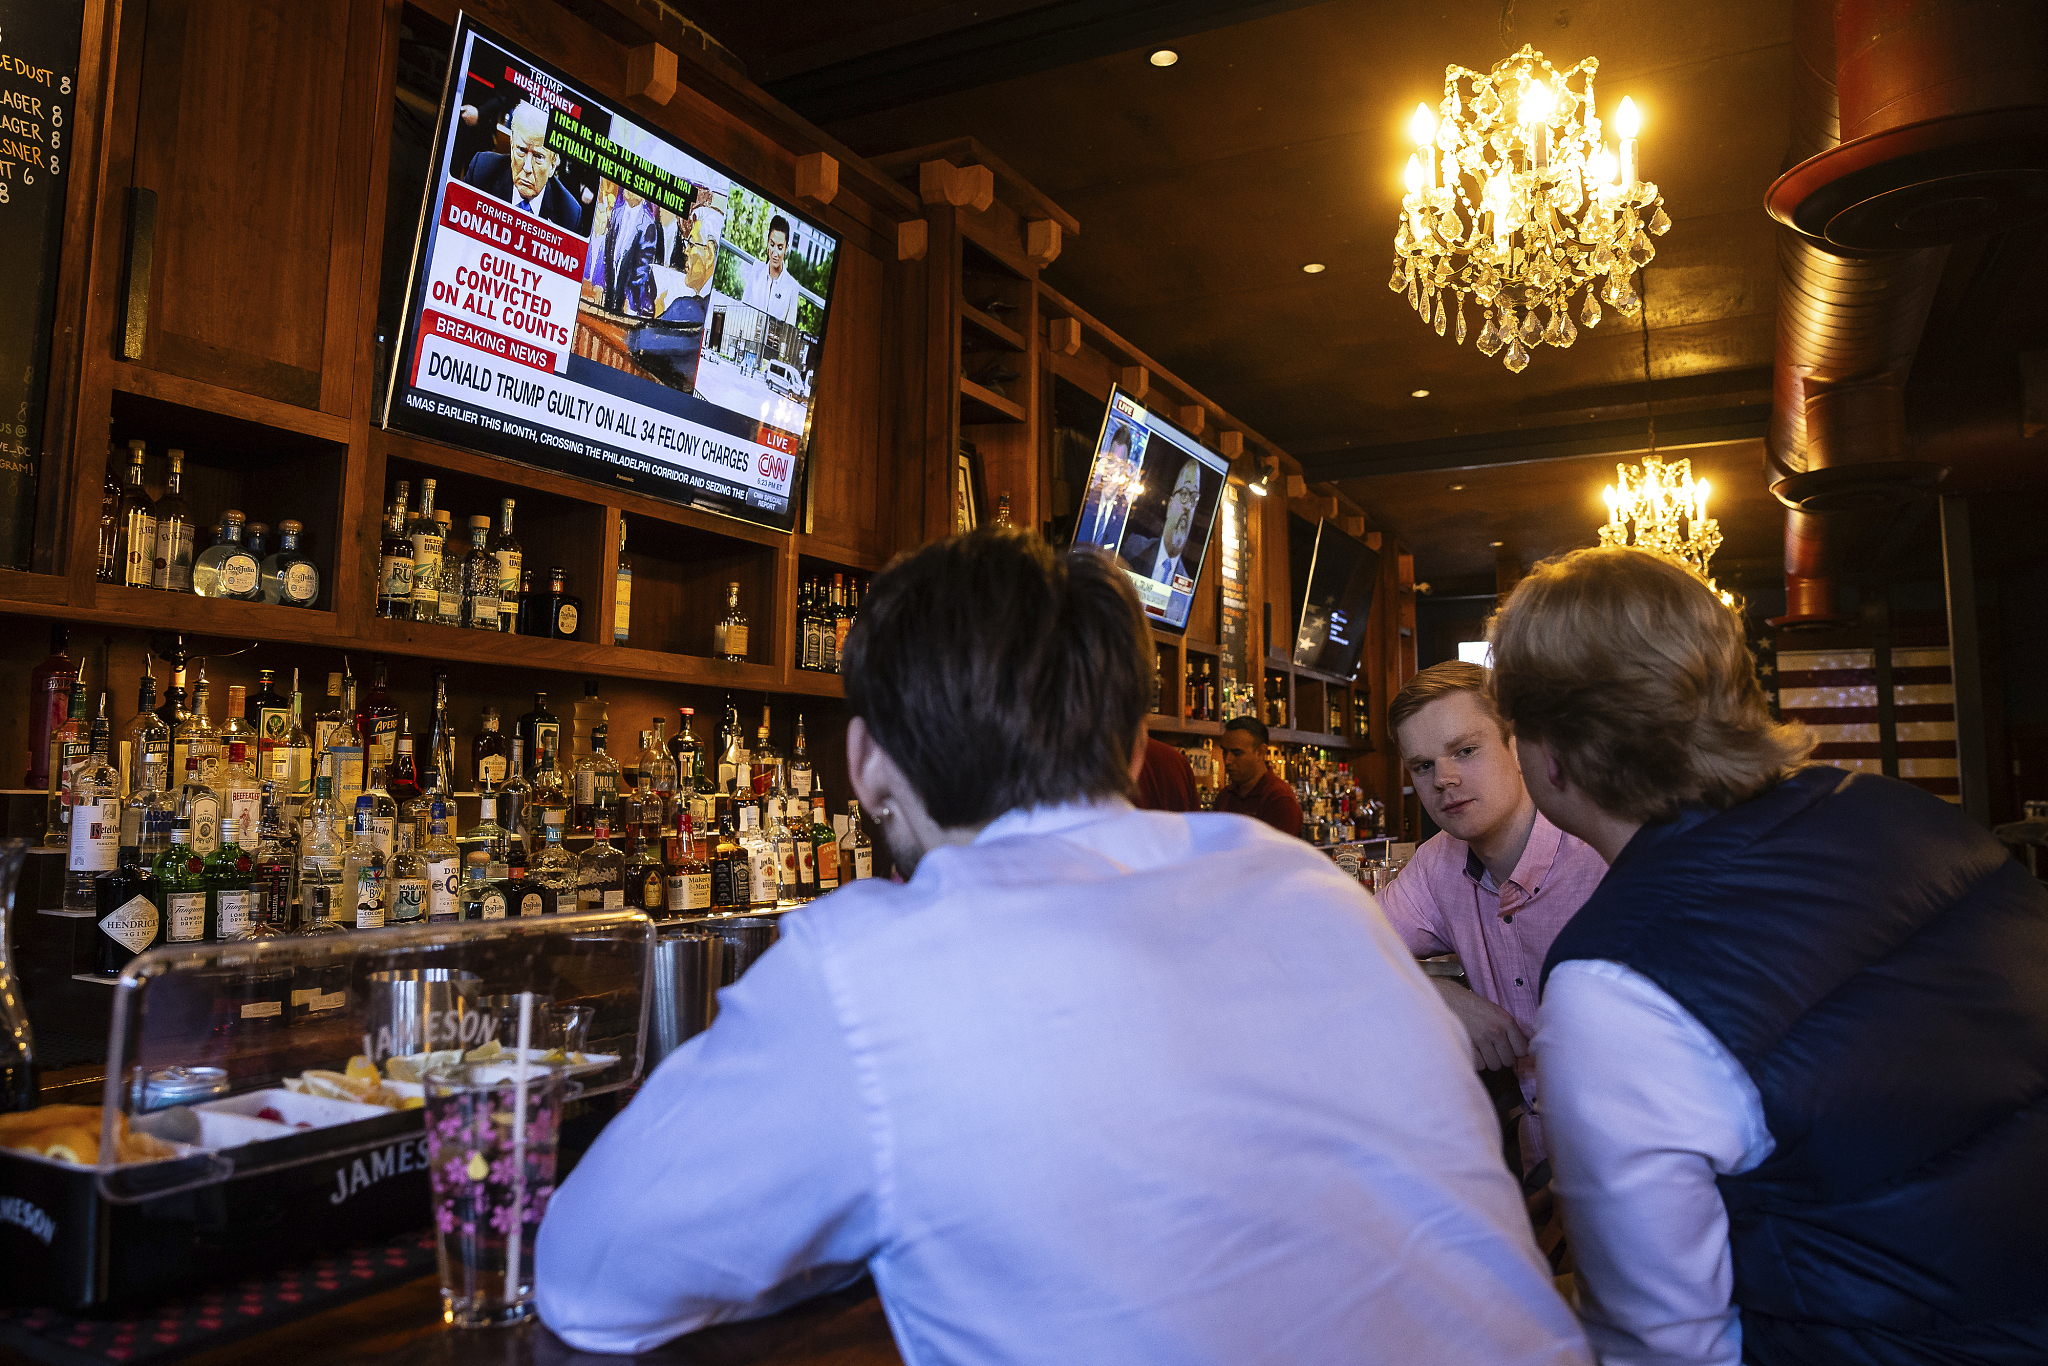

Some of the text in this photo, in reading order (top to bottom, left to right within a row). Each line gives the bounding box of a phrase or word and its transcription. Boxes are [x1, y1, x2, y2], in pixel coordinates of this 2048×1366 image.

[14, 57, 54, 88] DUST
[60, 76, 72, 95] 8
[513, 72, 575, 114] HUSH MONEY
[530, 68, 563, 94] TRUMP
[52, 105, 63, 128] 8
[529, 93, 554, 114] TRIA
[51, 130, 61, 150] 8
[554, 111, 578, 133] THEN
[580, 124, 592, 142] HE
[633, 153, 653, 173] FIND
[23, 167, 35, 185] 6
[50, 155, 60, 175] 8
[549, 129, 686, 213] ACTUALLY THEY'VE SENT A NOTE
[449, 204, 579, 273] DONALD J. TRUMP
[476, 200, 563, 247] FORMER PRESIDENT
[480, 253, 542, 291] GUILTY
[456, 266, 551, 318] CONVICTED
[432, 281, 568, 345] ON ALL COUNTS
[436, 317, 548, 368] BREAKING NEWS
[428, 351, 749, 472] DONALD TRUMP GUILTY ON ALL 34 FELONY CHARGES
[437, 403, 478, 425] EARLIER
[480, 414, 501, 431] THIS
[502, 422, 538, 443] MONTH,
[540, 432, 584, 454] CROSSING
[585, 445, 601, 460] THE
[602, 450, 651, 474] PHILADELPHI
[651, 464, 689, 484] CORRIDOR
[689, 475, 705, 488] AND
[705, 480, 731, 496] SEIZING
[732, 488, 745, 499] THE
[766, 433, 788, 450] LIVE
[758, 453, 789, 482] CNN
[594, 775, 614, 787] KNOB
[445, 875, 459, 898] Q
[330, 1137, 431, 1205] JAMES
